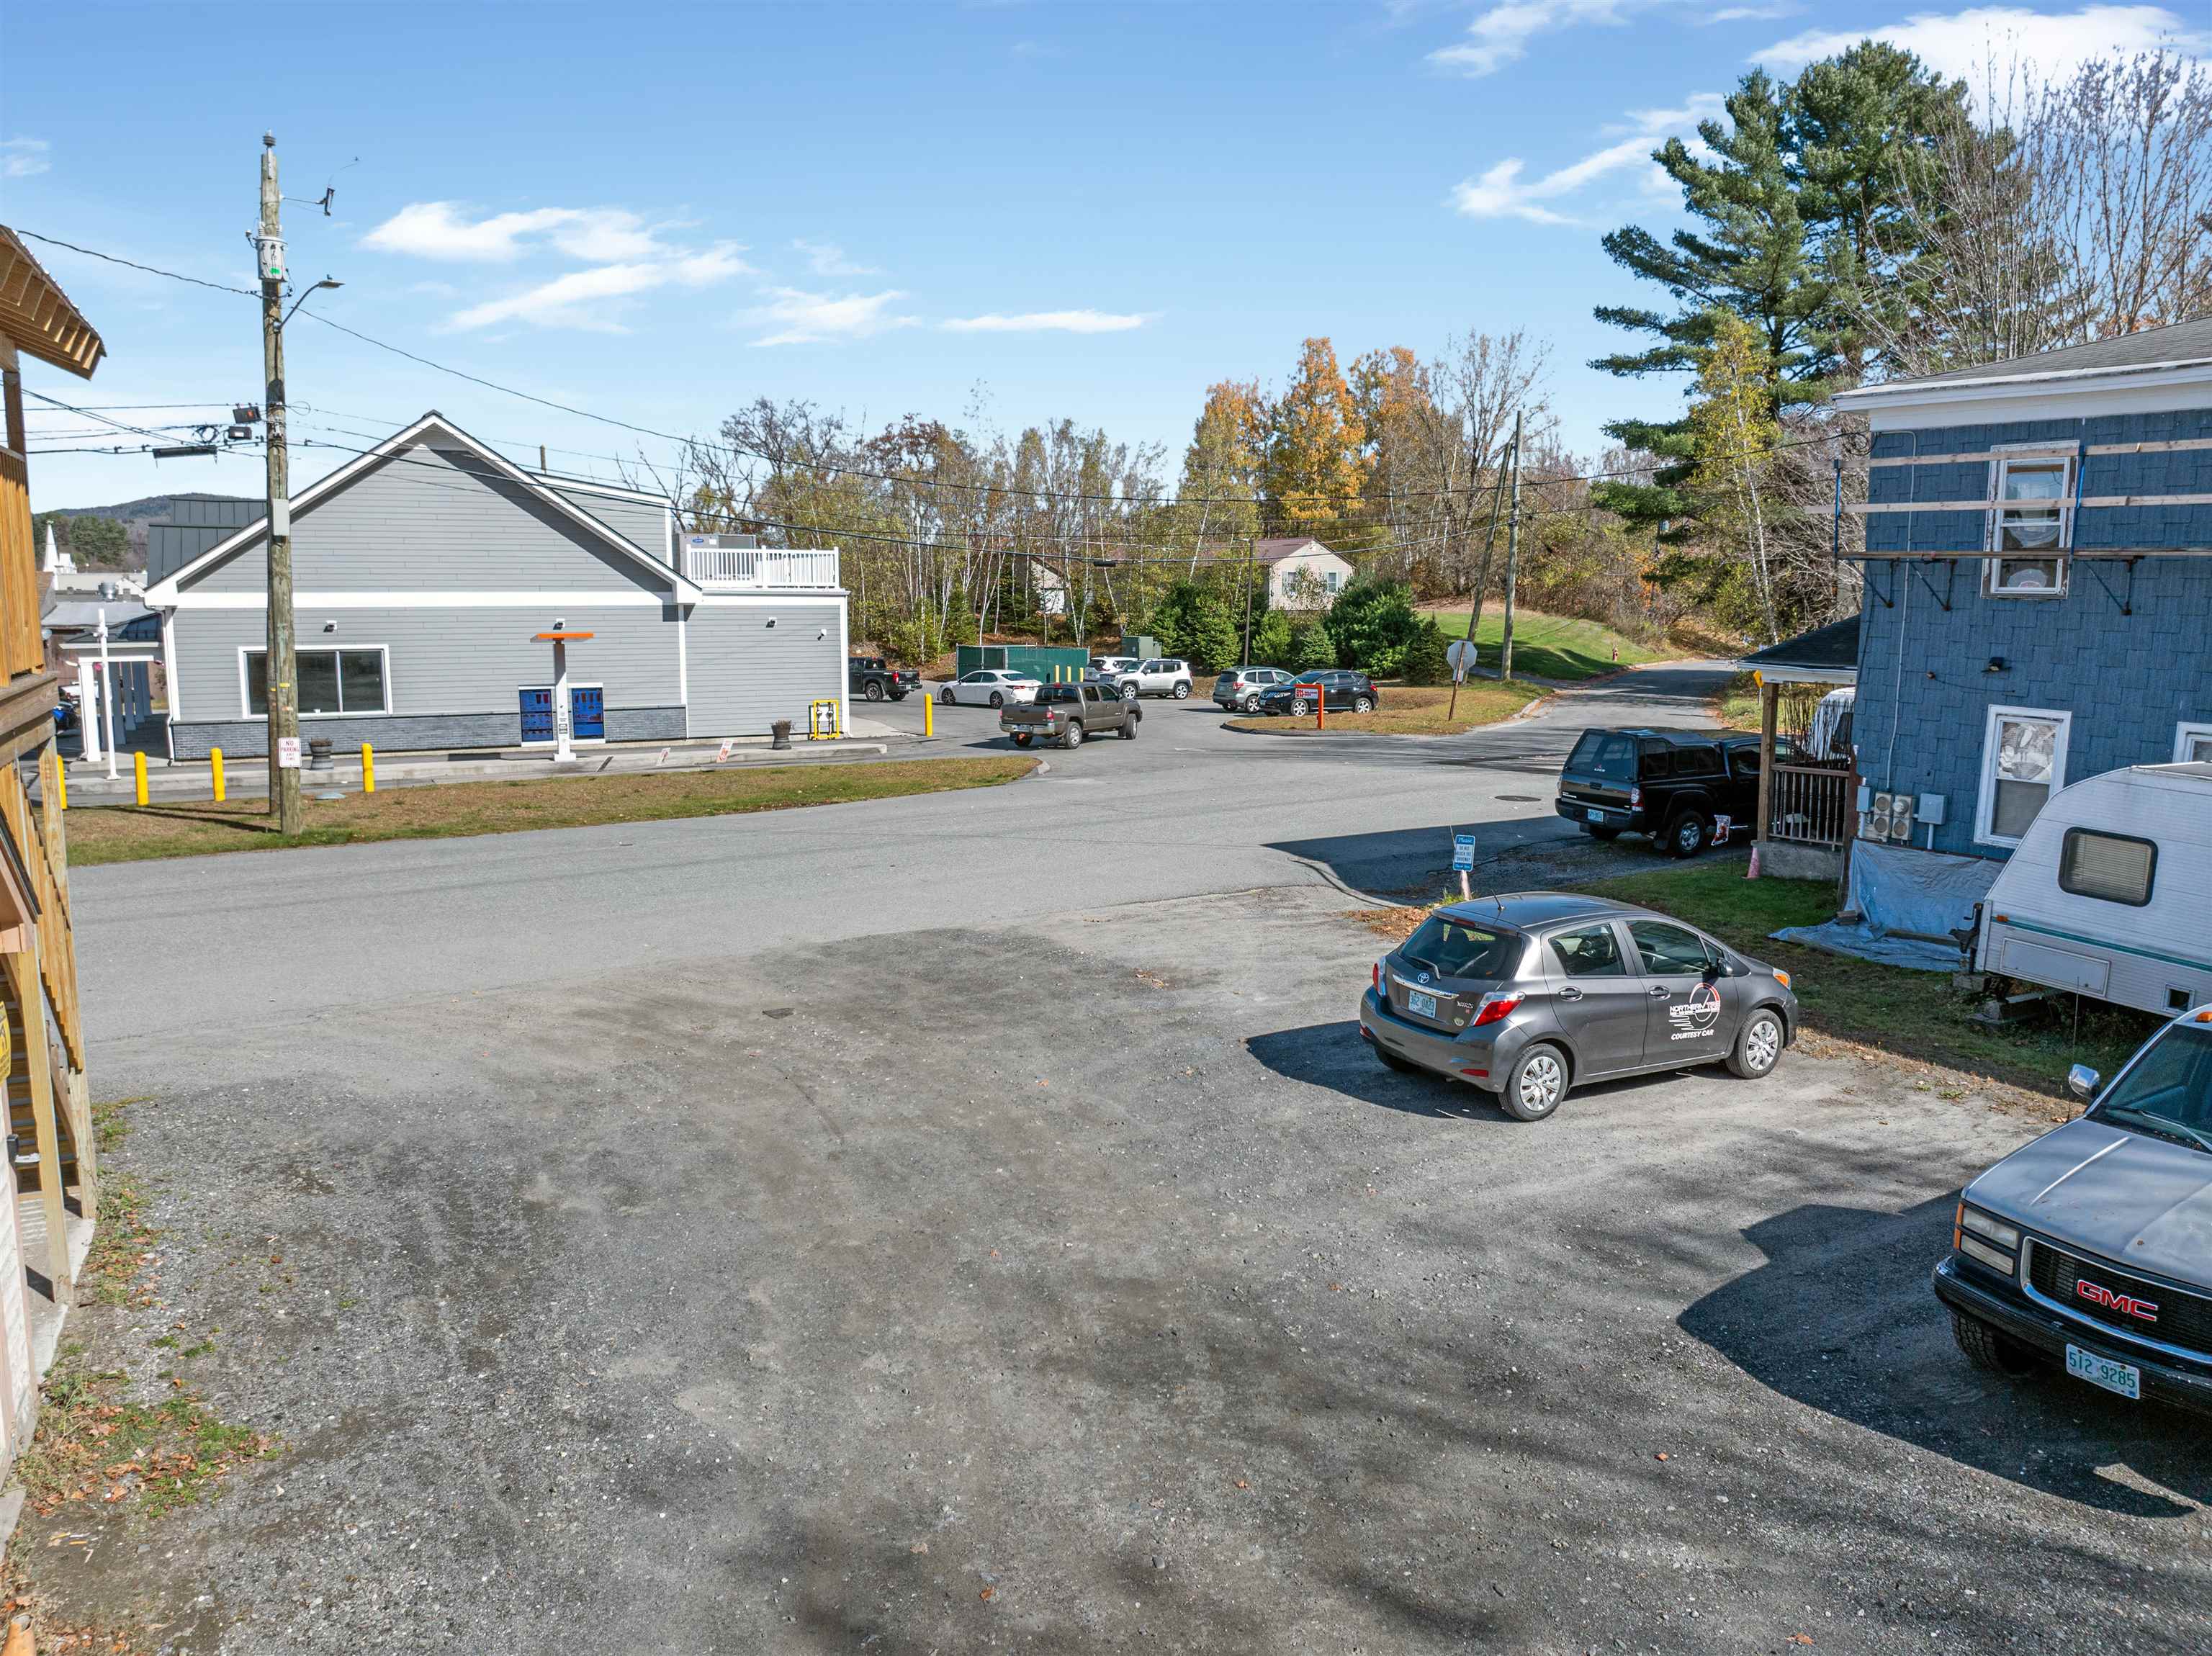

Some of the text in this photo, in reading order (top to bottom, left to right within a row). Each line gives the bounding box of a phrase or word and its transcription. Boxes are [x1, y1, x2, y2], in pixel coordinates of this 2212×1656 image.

[1670, 1004, 1704, 1012] NORTHERN
[1671, 1031, 1701, 1040] COURTESY
[2077, 1279, 2158, 1322] GMC
[2069, 1351, 2092, 1374] 512
[2100, 1364, 2136, 1388] 9285
